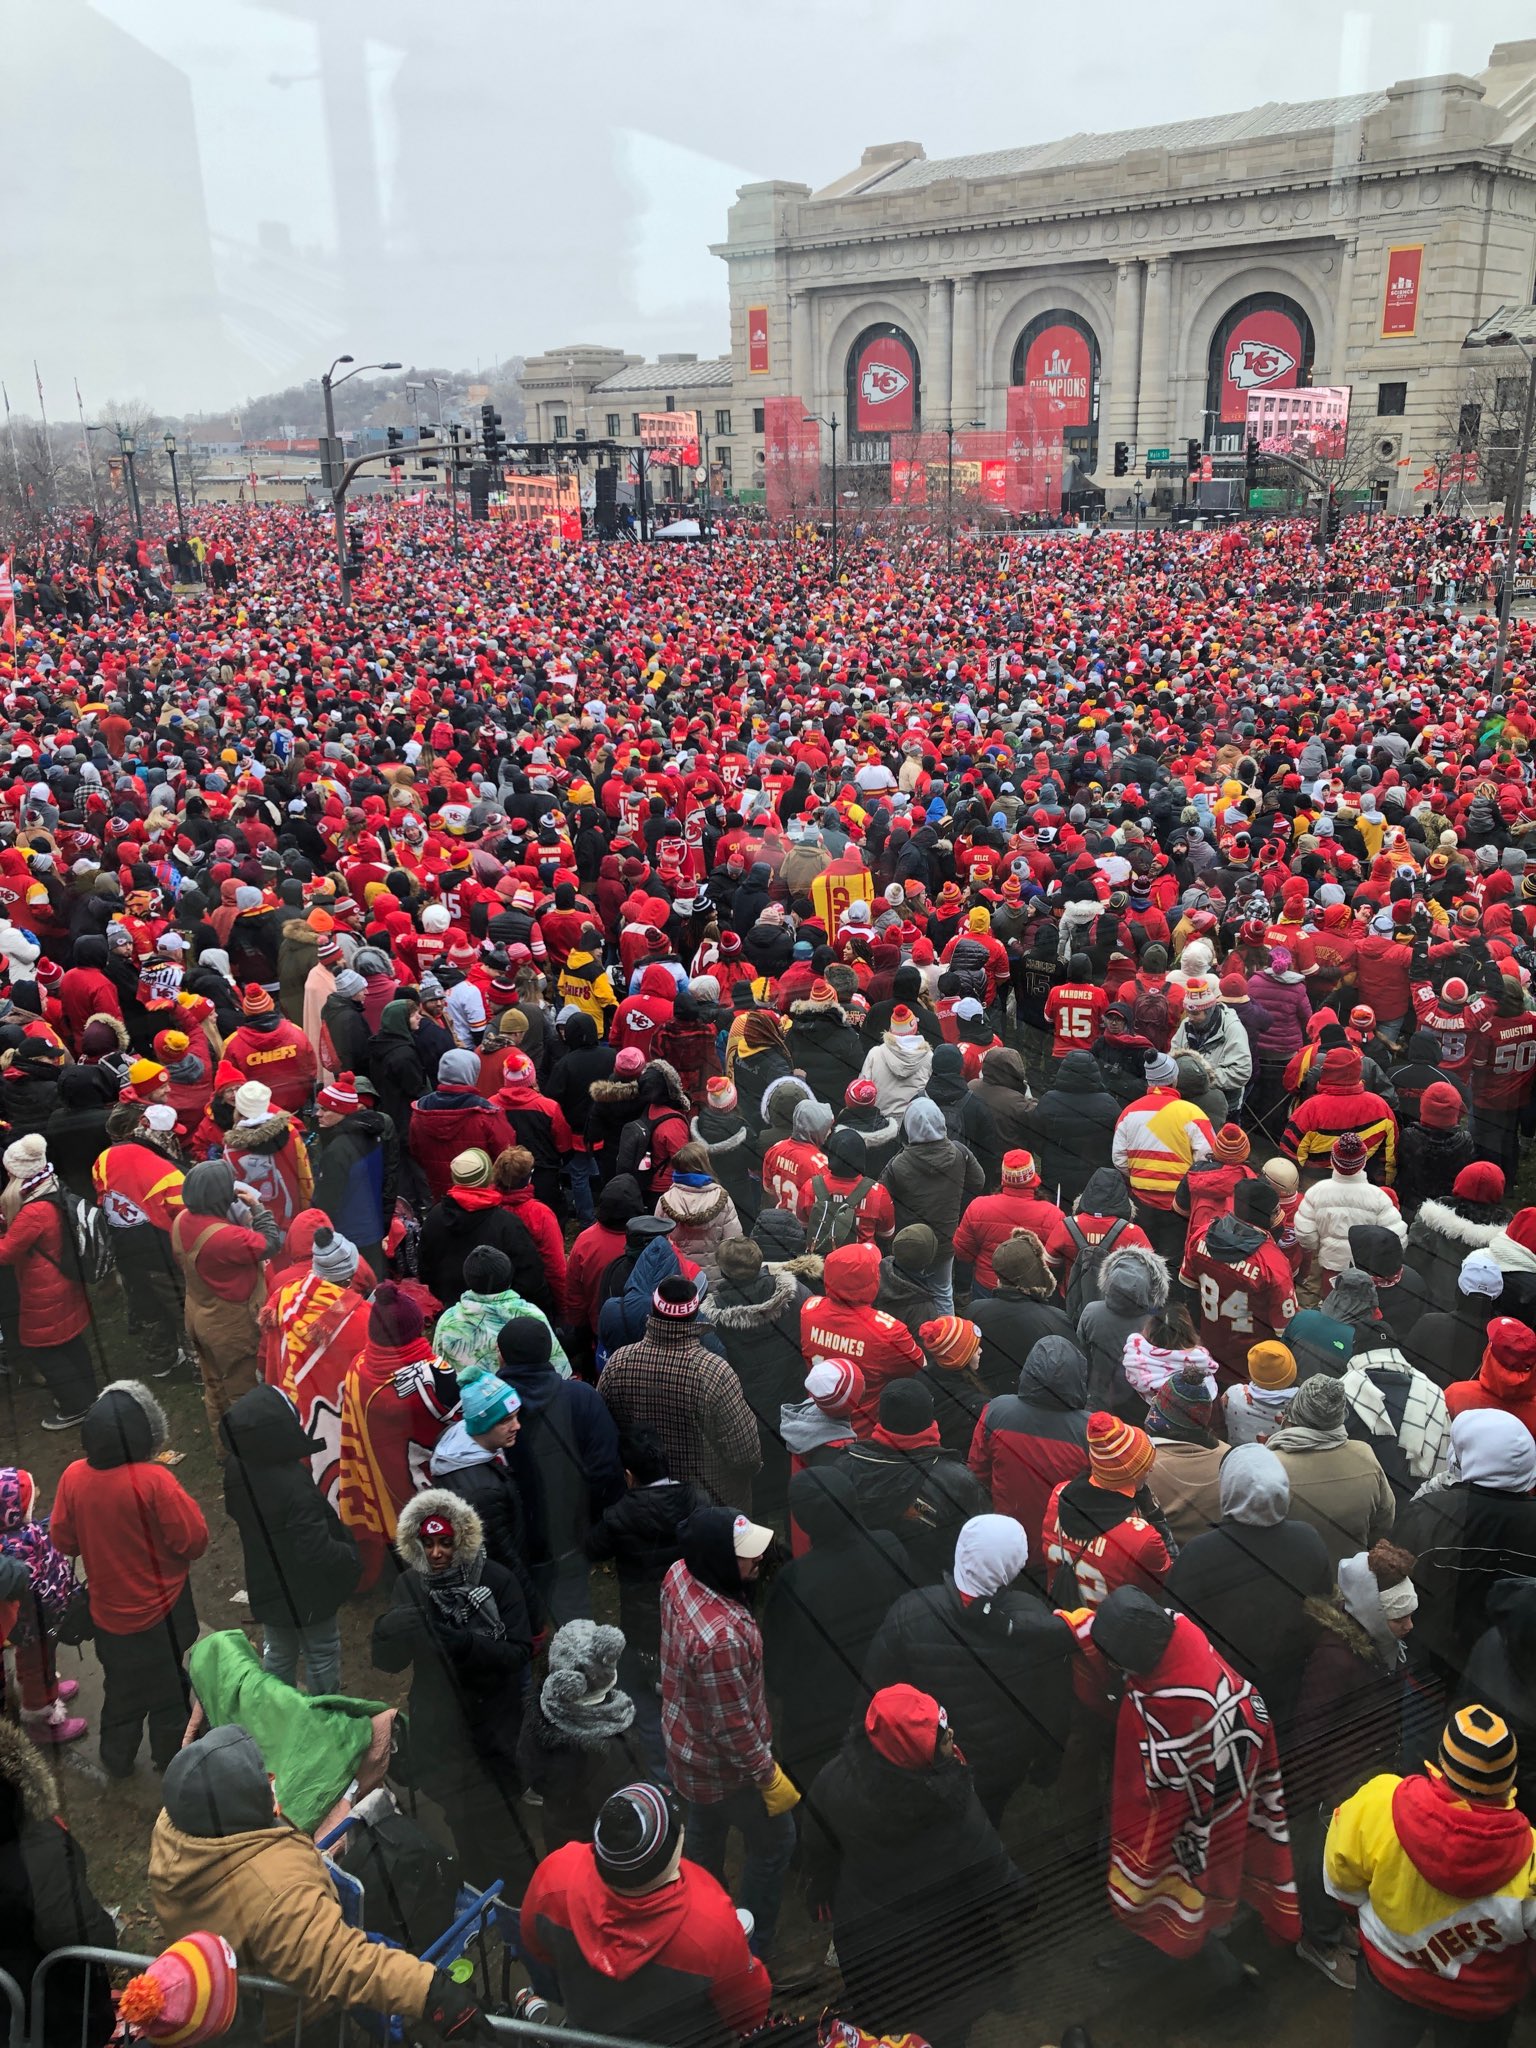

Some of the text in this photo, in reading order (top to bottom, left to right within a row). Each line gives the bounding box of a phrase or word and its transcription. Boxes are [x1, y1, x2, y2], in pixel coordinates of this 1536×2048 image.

[1244, 350, 1279, 378] KC
[872, 371, 898, 394] KC
[1029, 377, 1087, 398] CHAMPIONS
[722, 765, 740, 783] 87
[974, 854, 989, 862] KELCE
[564, 981, 591, 1000] CHIEFS
[1026, 971, 1050, 996] 15
[1059, 989, 1093, 1001] MAHOMES
[1058, 1006, 1092, 1038] 15
[1424, 1012, 1465, 1030] D.THOMAS
[1500, 1024, 1533, 1040] HOUSTON
[246, 1044, 297, 1066] CHIEFS
[1493, 1039, 1536, 1075] 50
[657, 1298, 699, 1315] CHIEFS
[1198, 1272, 1254, 1334] 84
[810, 1325, 865, 1357] MAHOMES
